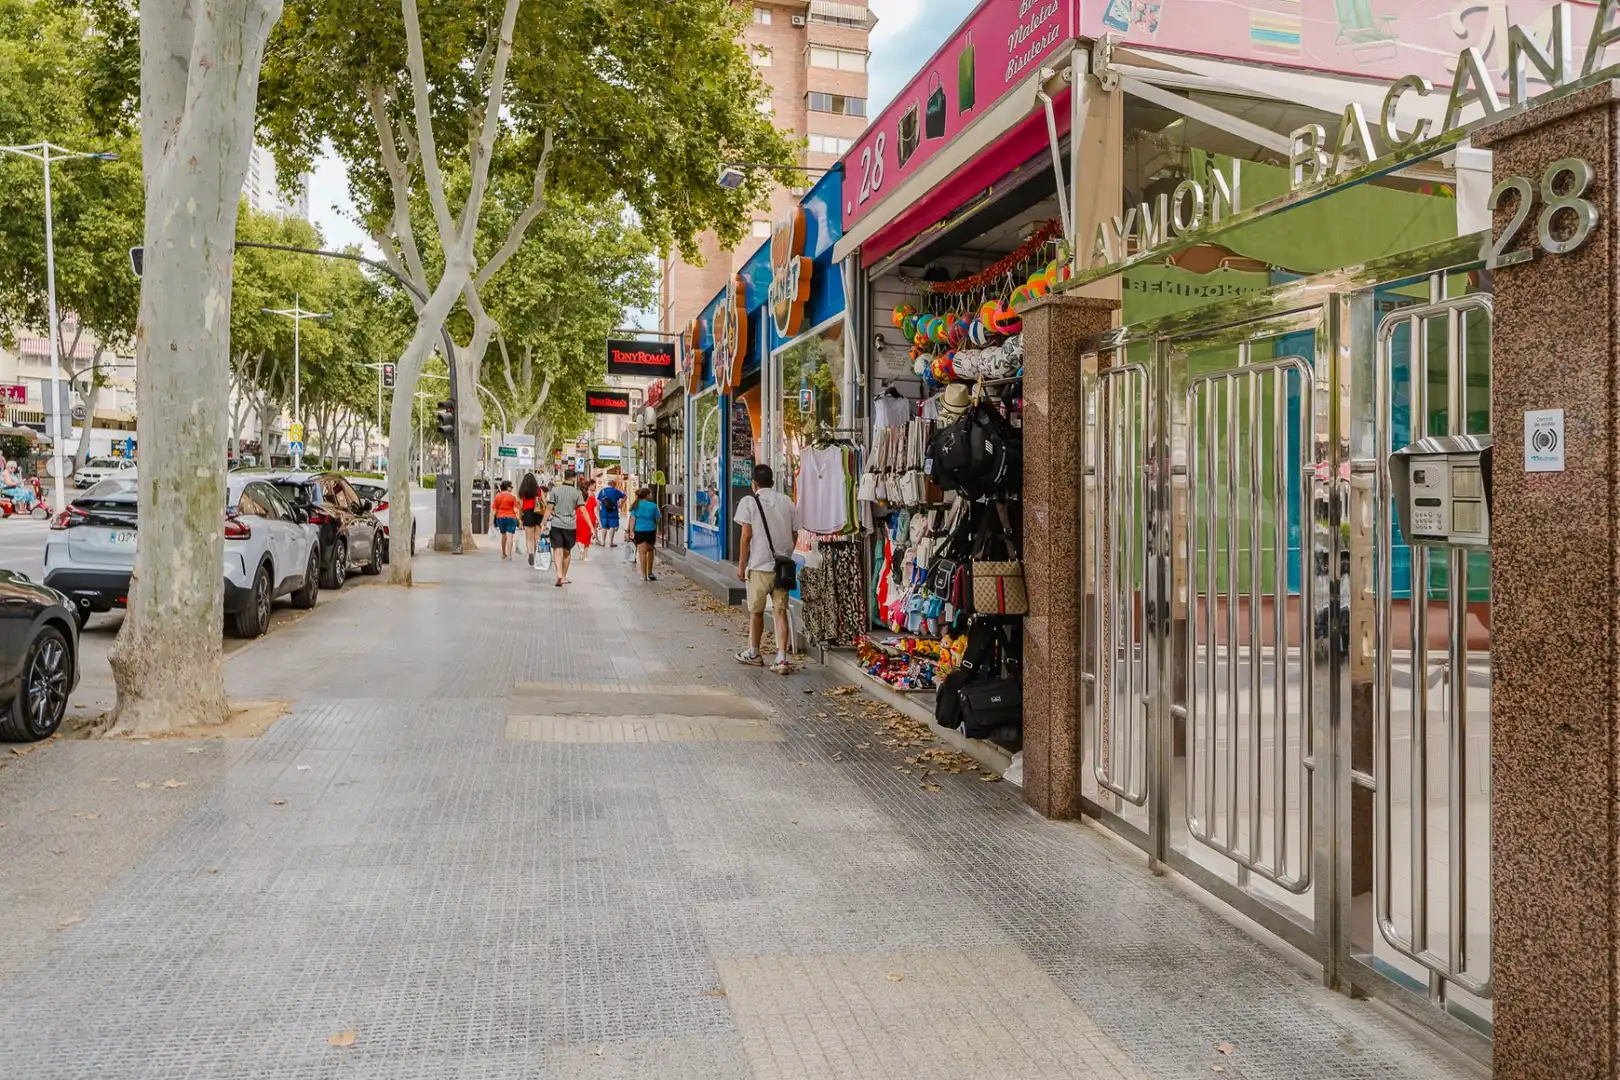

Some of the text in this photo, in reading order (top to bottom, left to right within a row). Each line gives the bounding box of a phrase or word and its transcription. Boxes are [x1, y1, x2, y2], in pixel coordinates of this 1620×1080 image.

[1005, 23, 1060, 83] Bisuteria
[1007, 0, 1059, 53] Maletas
[859, 131, 886, 205] 28
[1478, 157, 1598, 270] 28
